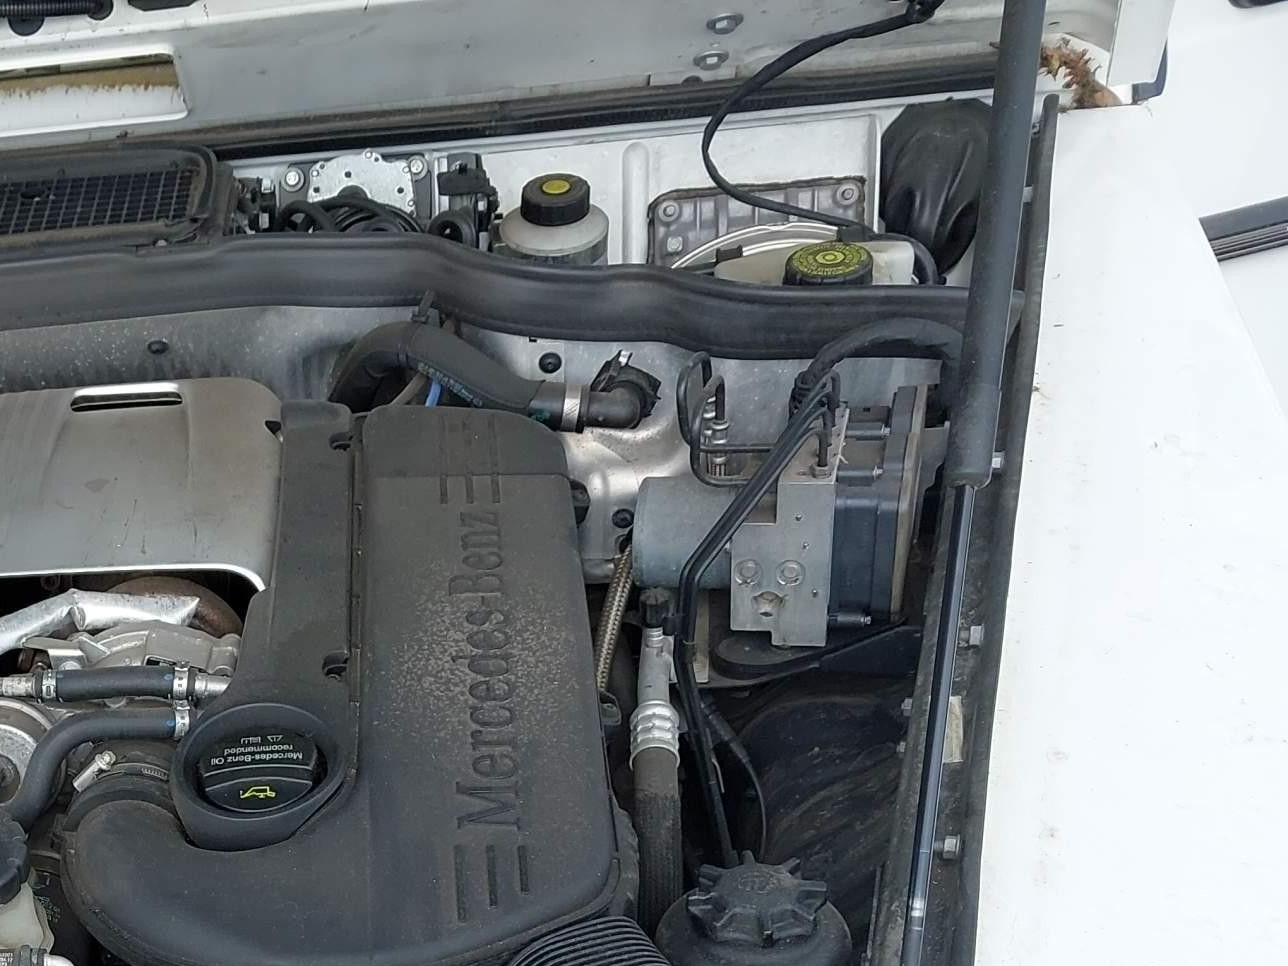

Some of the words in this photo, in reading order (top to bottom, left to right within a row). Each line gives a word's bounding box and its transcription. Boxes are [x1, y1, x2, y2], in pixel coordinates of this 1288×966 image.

[447, 510, 523, 830] Mercedes-Benz
[224, 744, 293, 755] recommended
[211, 757, 224, 765] Oil
[226, 752, 303, 762] Mercedes-Benz
